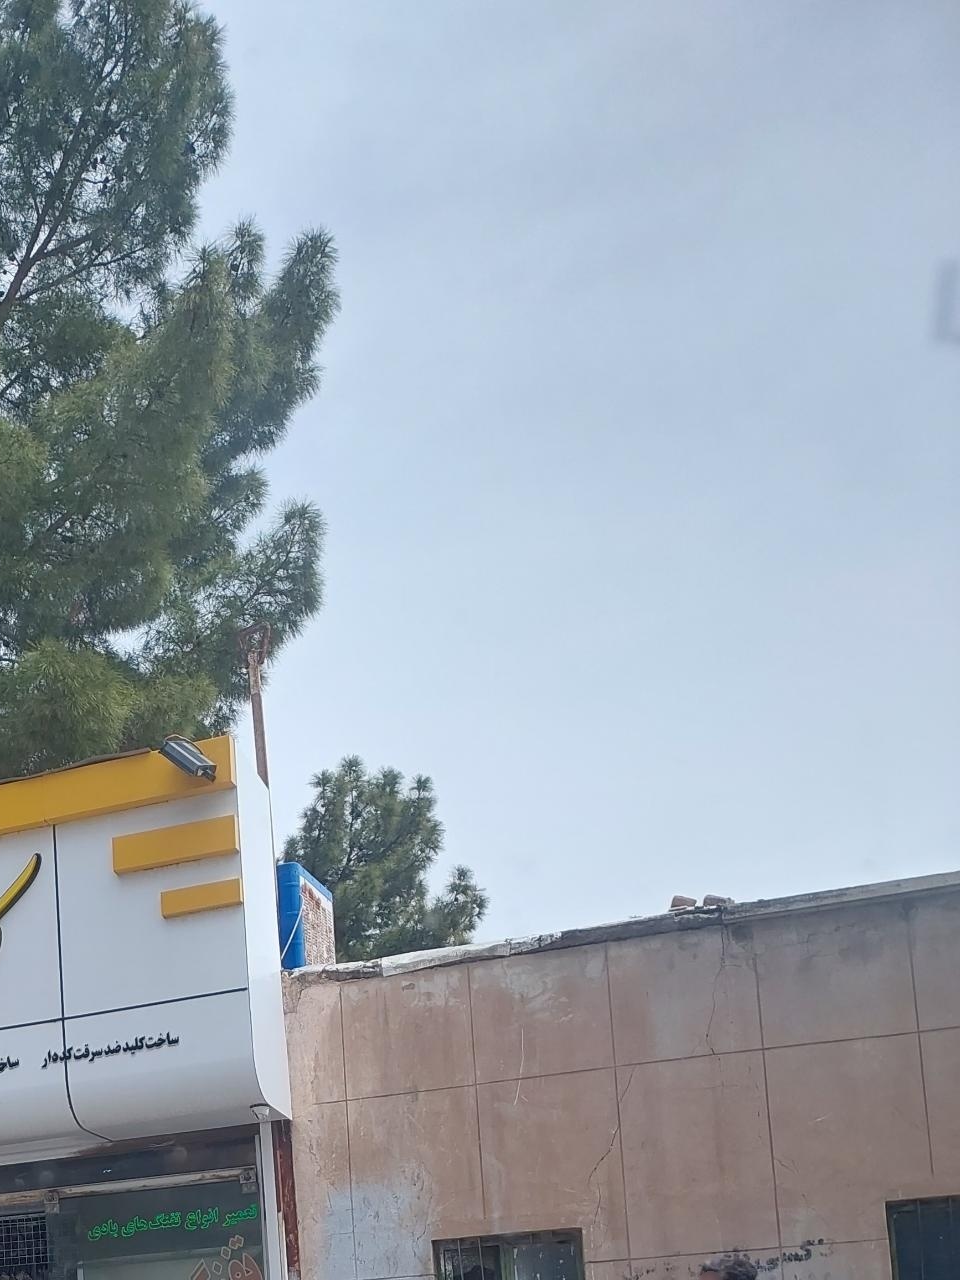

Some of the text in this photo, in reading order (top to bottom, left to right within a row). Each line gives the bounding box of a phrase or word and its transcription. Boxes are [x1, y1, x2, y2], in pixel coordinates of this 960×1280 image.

[123, 1036, 146, 1055] کلید
[145, 1031, 180, 1050] ساخت
[185, 1207, 219, 1230] انواع
[223, 1205, 258, 1227] تعمیر
[88, 1219, 119, 1240] بادی
